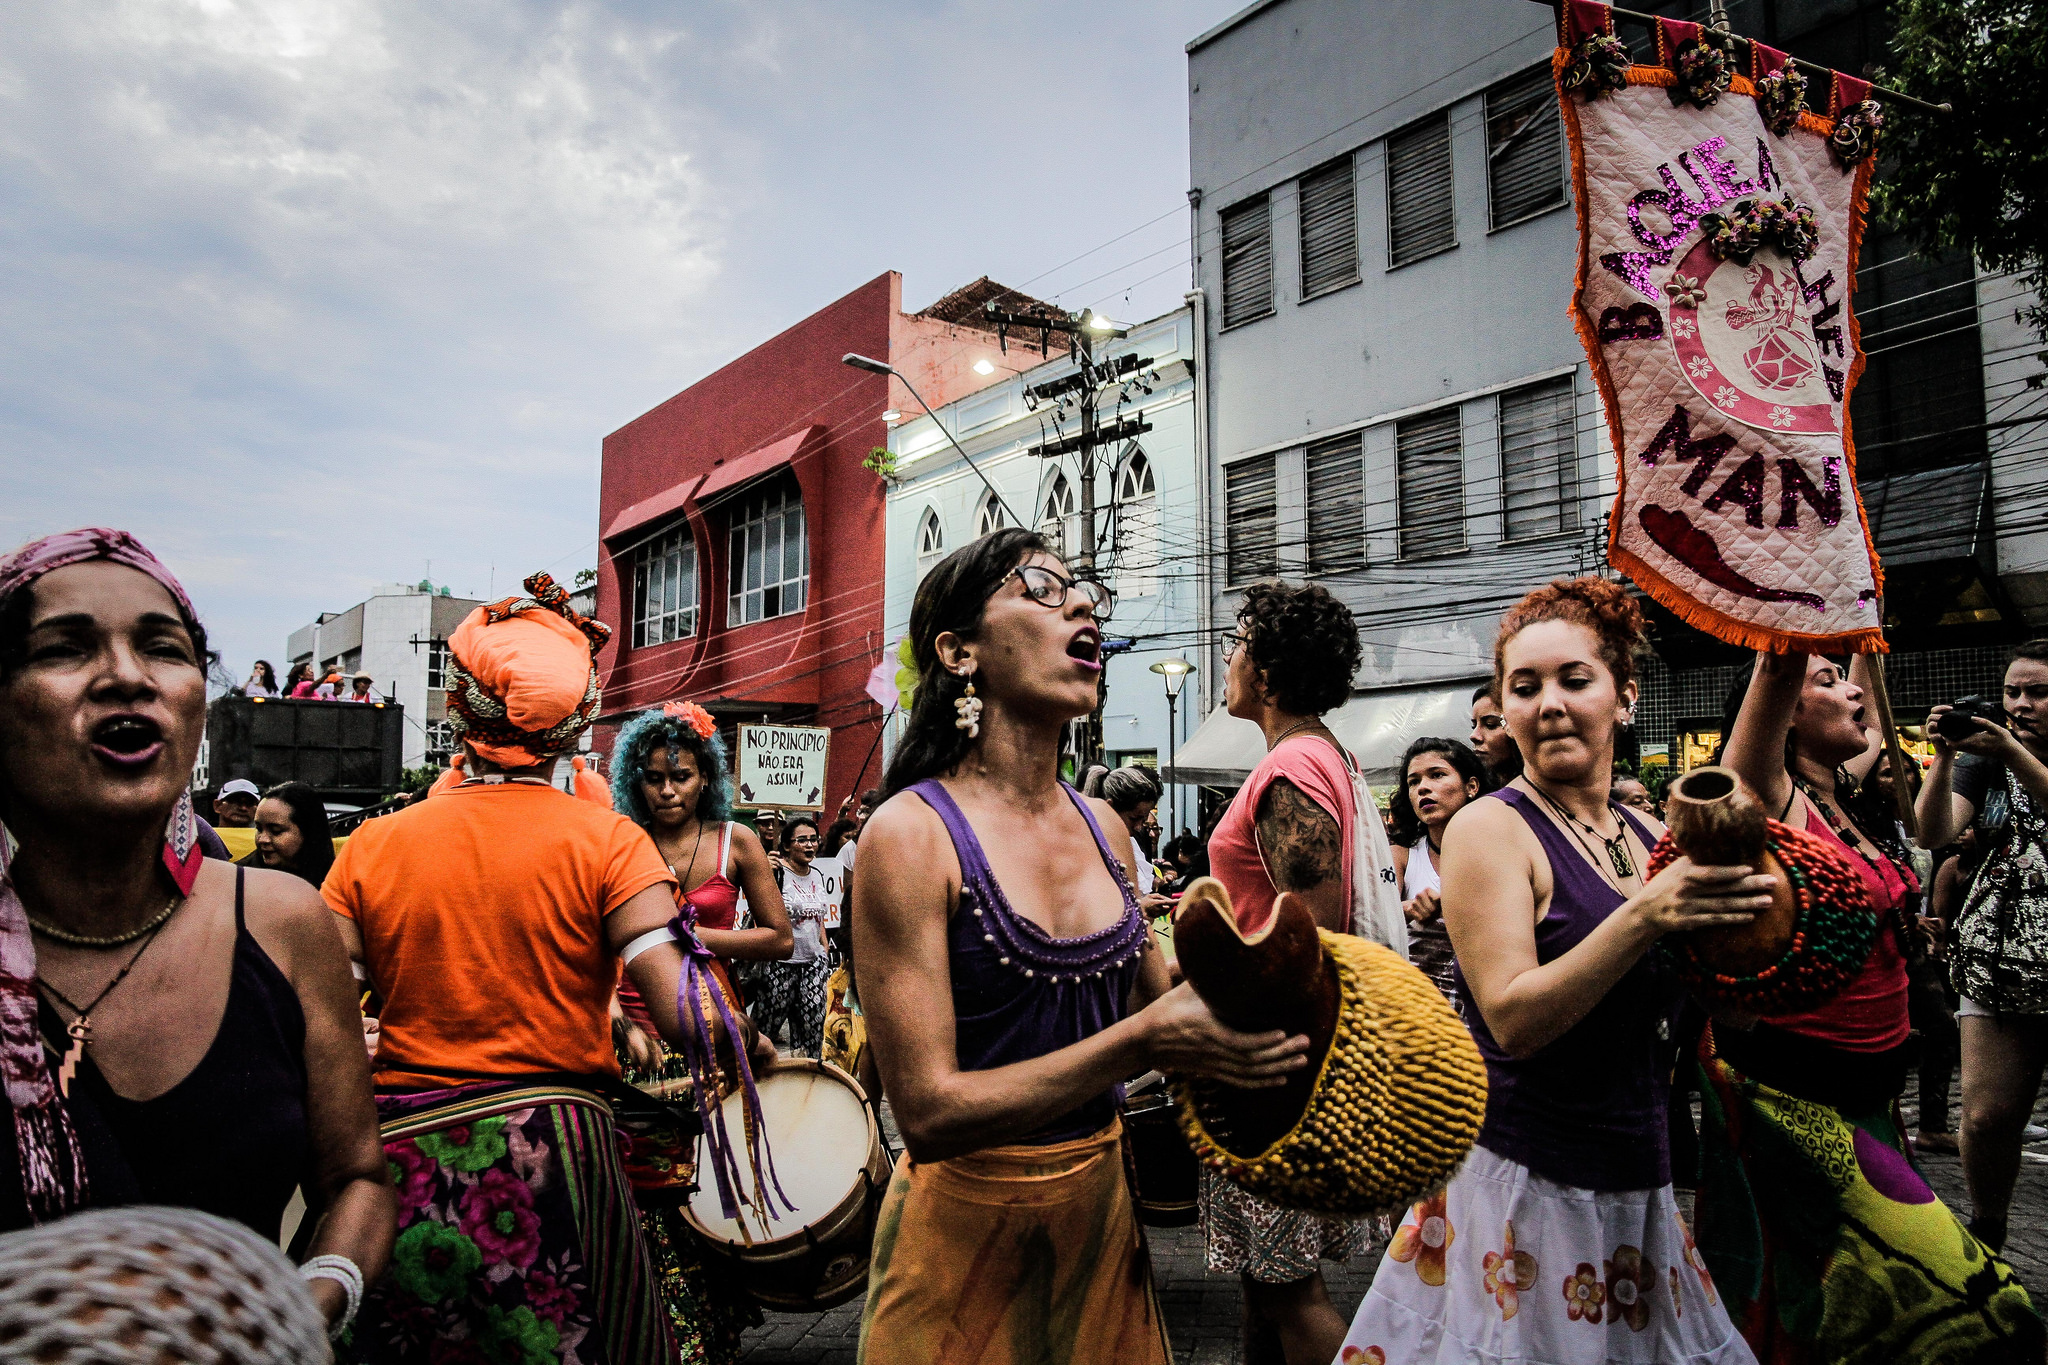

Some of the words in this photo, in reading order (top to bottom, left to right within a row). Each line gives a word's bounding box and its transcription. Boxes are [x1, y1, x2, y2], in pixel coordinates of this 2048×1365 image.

[1599, 135, 1758, 343] BAQUE
[747, 729, 768, 749] NO
[771, 729, 826, 752] PRINCÍPIO
[758, 750, 780, 769] NÃO
[783, 756, 804, 769] ERA
[766, 770, 804, 793] ASSIM!
